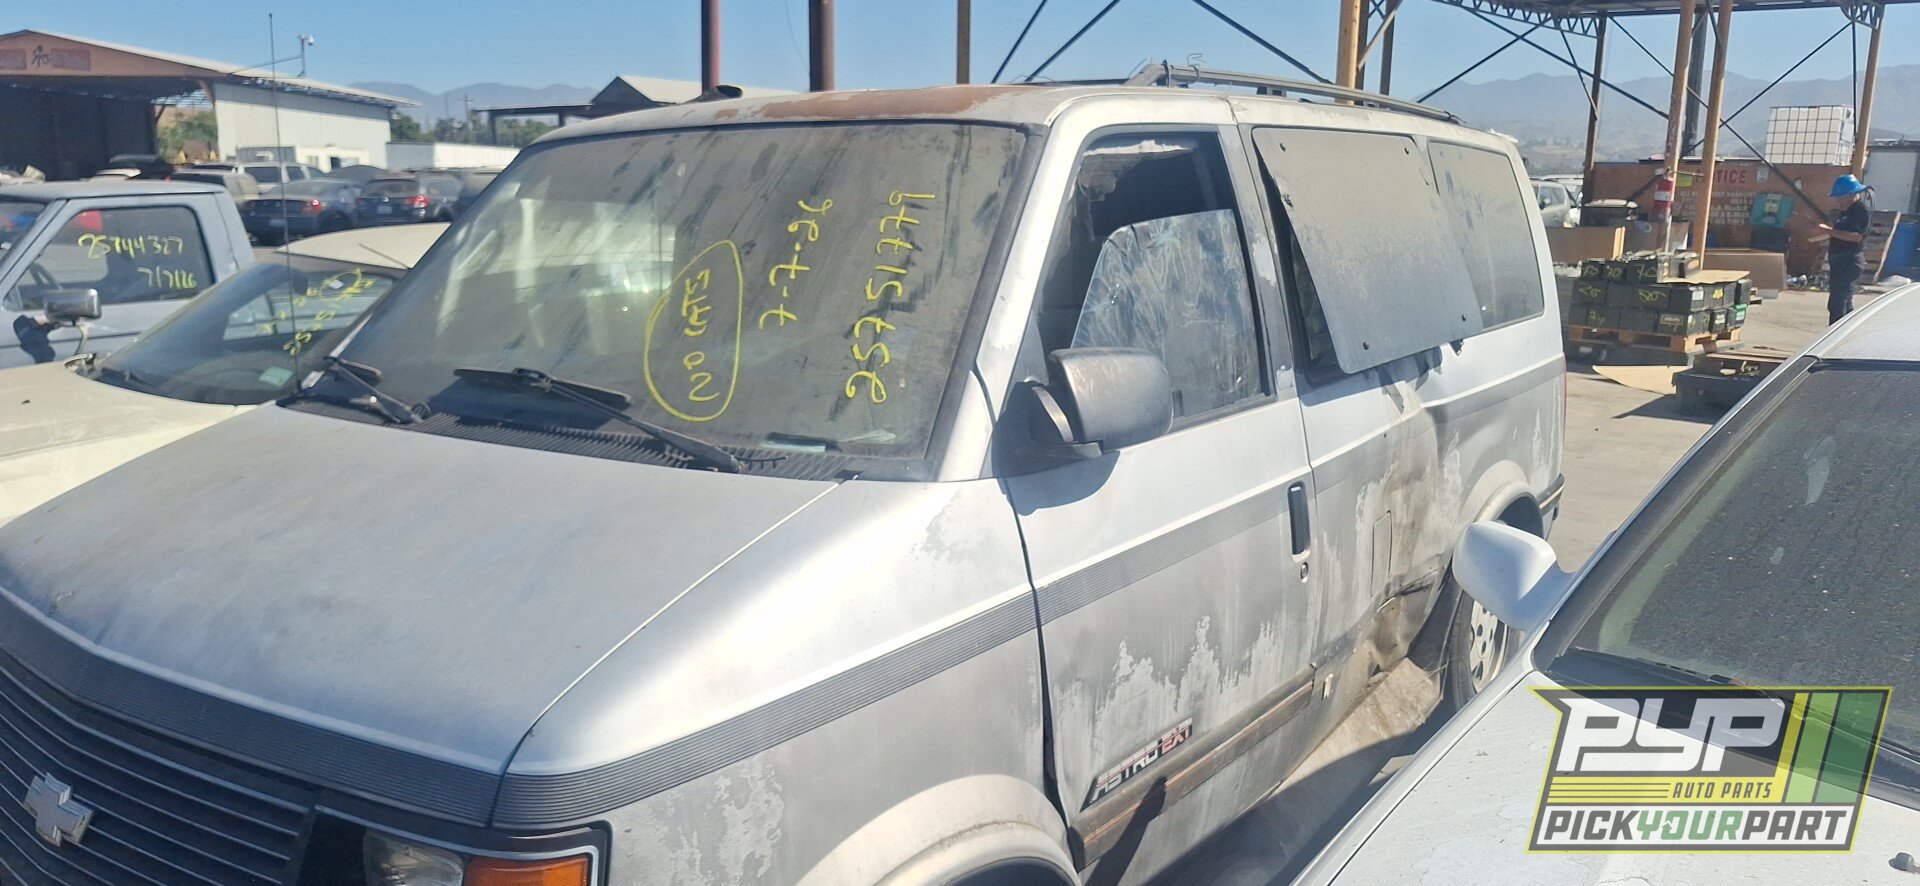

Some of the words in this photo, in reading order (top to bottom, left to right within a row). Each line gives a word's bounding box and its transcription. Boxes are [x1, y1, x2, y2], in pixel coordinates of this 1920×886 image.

[78, 232, 184, 260] 25744327
[759, 198, 834, 330] 7-7-26
[845, 190, 936, 404] 25751779
[683, 351, 721, 402] NO
[1088, 738, 1159, 804] ASTRO
[1161, 717, 1193, 754] EXT
